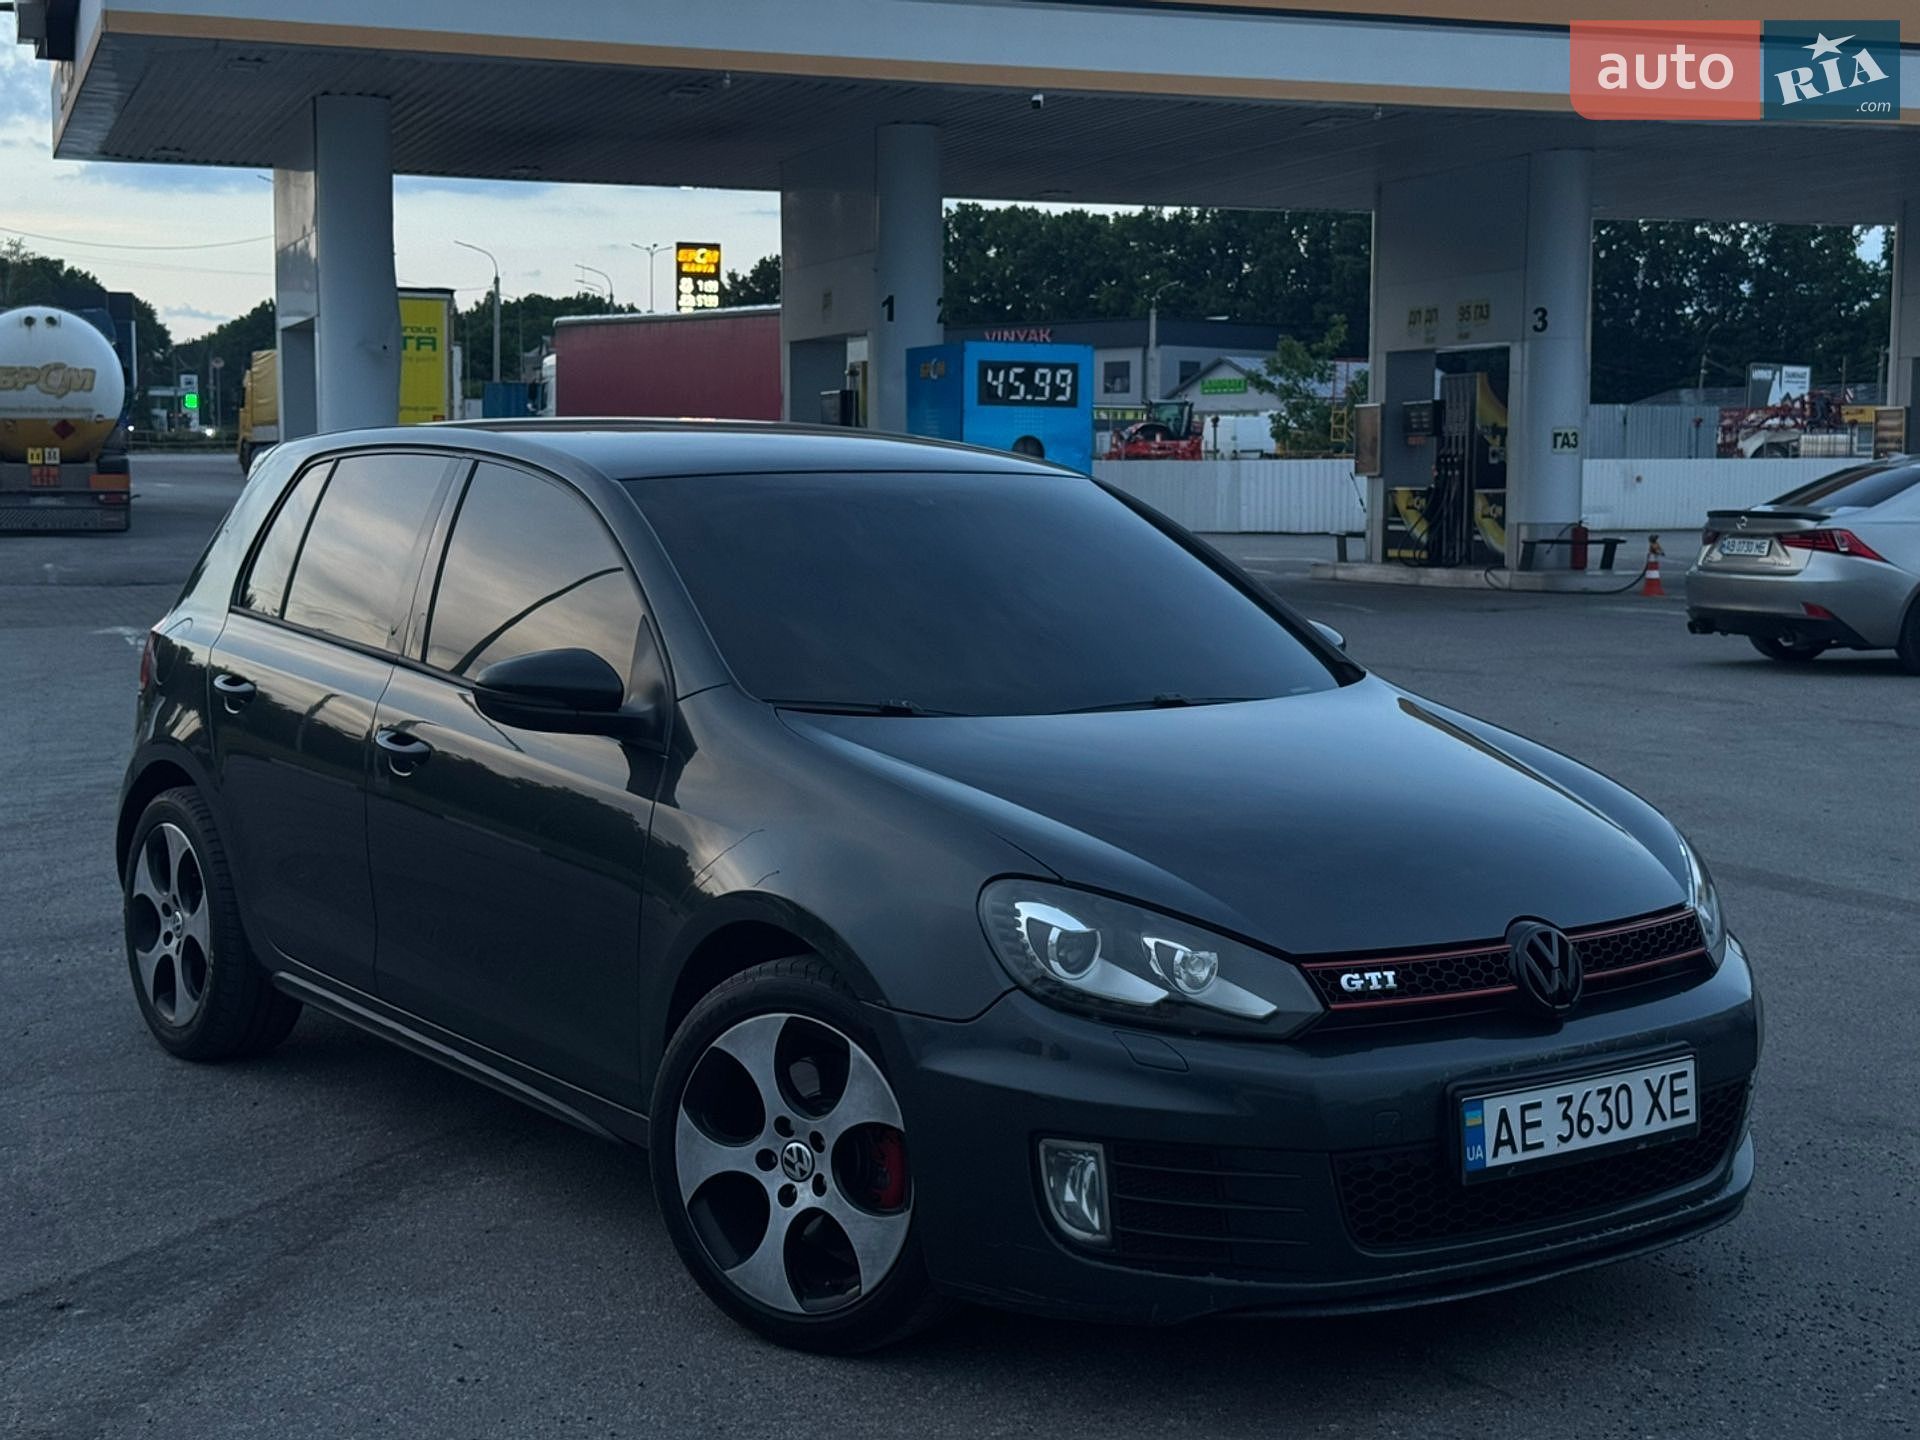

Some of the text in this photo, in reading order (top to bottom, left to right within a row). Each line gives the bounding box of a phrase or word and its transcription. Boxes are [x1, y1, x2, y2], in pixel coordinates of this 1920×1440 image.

[882, 295, 894, 322] 1
[1532, 307, 1548, 333] 3
[984, 328, 1051, 342] VINYAK
[986, 367, 1073, 401] 45.99
[1553, 431, 1578, 450] ГАЗ
[1341, 971, 1398, 991] GTI
[1492, 1070, 1691, 1159] AE 3630 XE
[1466, 1145, 1484, 1161] UA
